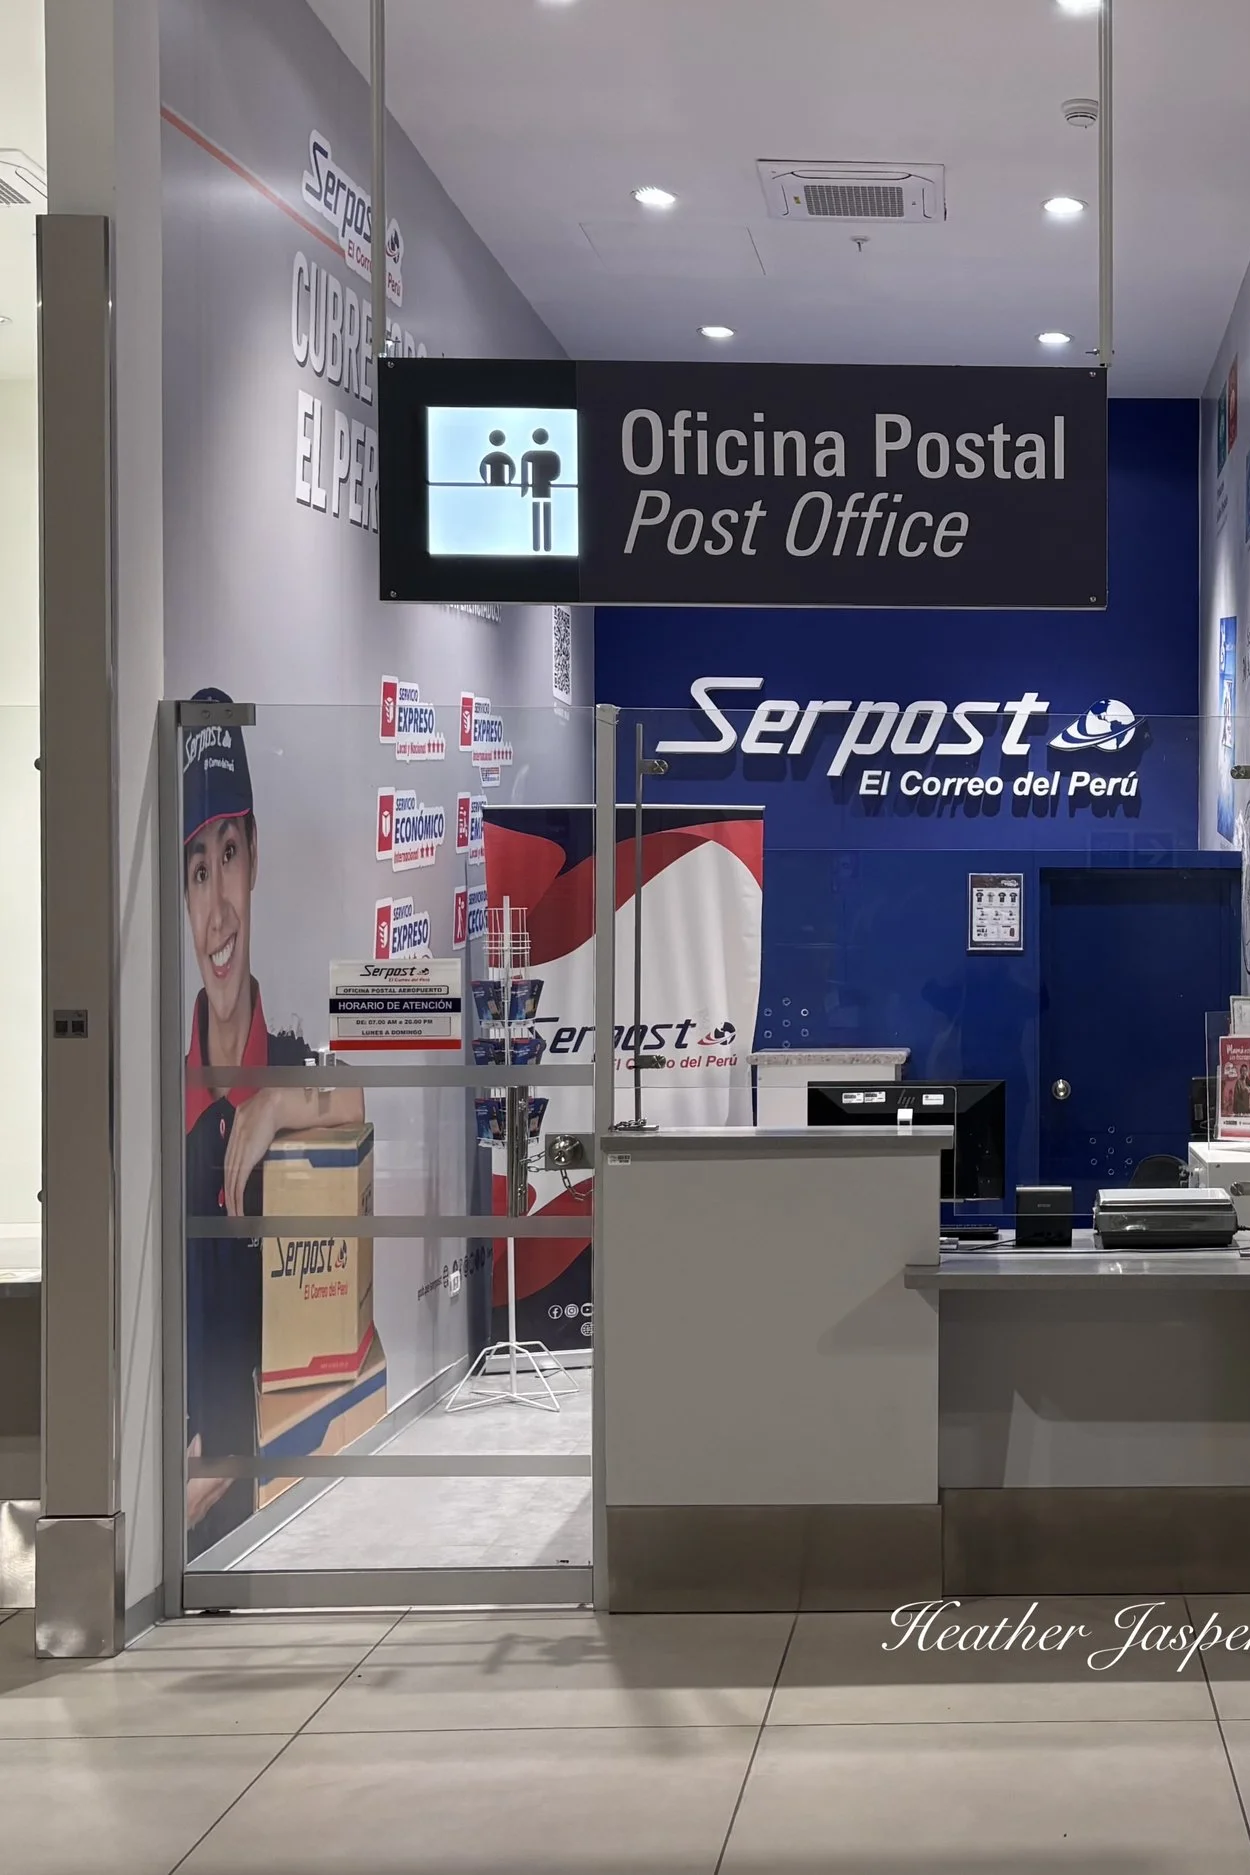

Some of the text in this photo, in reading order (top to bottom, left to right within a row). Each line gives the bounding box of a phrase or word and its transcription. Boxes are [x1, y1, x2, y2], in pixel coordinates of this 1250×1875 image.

[305, 141, 372, 244] Serpos
[291, 251, 373, 406] CUBRE
[621, 408, 1066, 480] Oficina Postal
[296, 389, 380, 533] EL PER
[623, 489, 970, 558] Post Office
[399, 687, 419, 702] SERVICIO
[397, 706, 435, 735] EXPRESO
[473, 718, 503, 743] EXPRESO
[655, 677, 1051, 777] Serpost
[859, 770, 1139, 798] El Correo del Perú
[396, 797, 416, 812] SERVICIO
[394, 811, 444, 845] ECONÓMICO
[393, 904, 412, 921] SERVICIO
[392, 918, 429, 954] EXPRESO
[360, 965, 417, 979] Serpost
[338, 999, 453, 1011] HORARIO DE ATENCIÓN
[680, 1056, 701, 1069] del
[705, 1054, 738, 1067] Perú
[271, 1237, 335, 1289] Serpost
[304, 1284, 310, 1300] El
[311, 1283, 328, 1299] Correo
